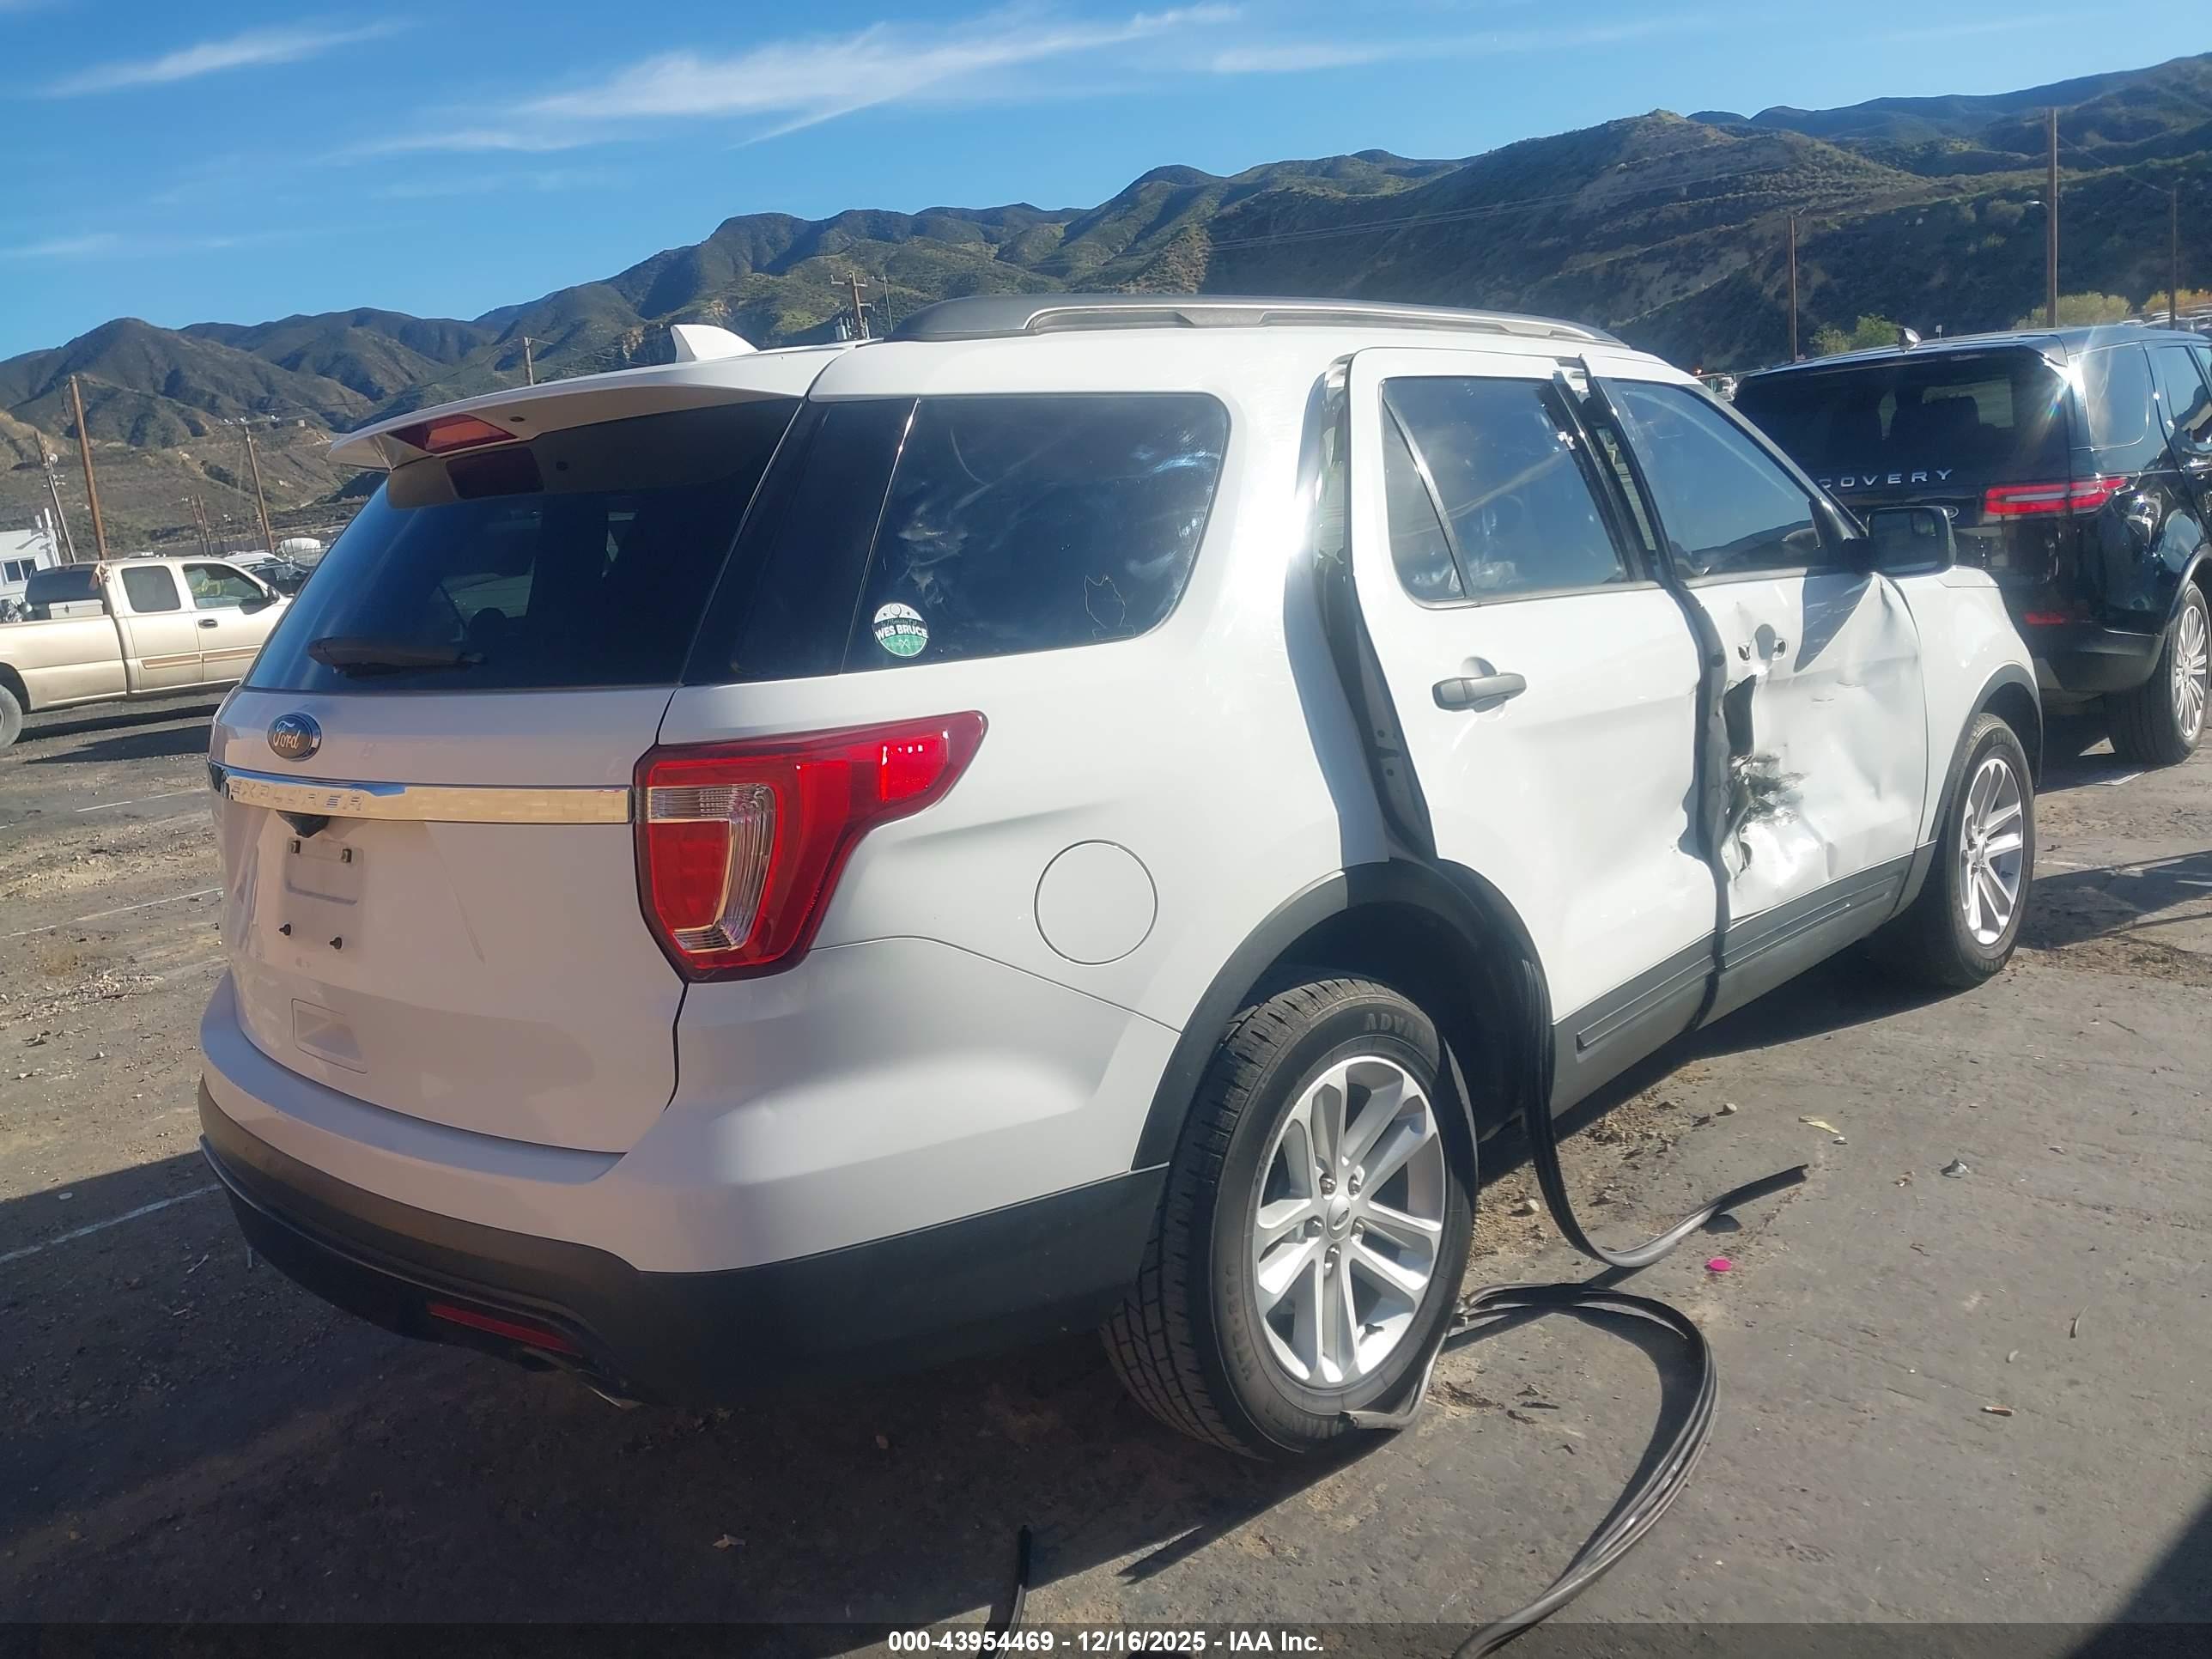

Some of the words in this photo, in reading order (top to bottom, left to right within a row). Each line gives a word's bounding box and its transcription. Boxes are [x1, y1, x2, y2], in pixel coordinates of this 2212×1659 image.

[875, 626, 896, 641] WES
[896, 624, 928, 638] BRUCE
[273, 720, 301, 750] Ford
